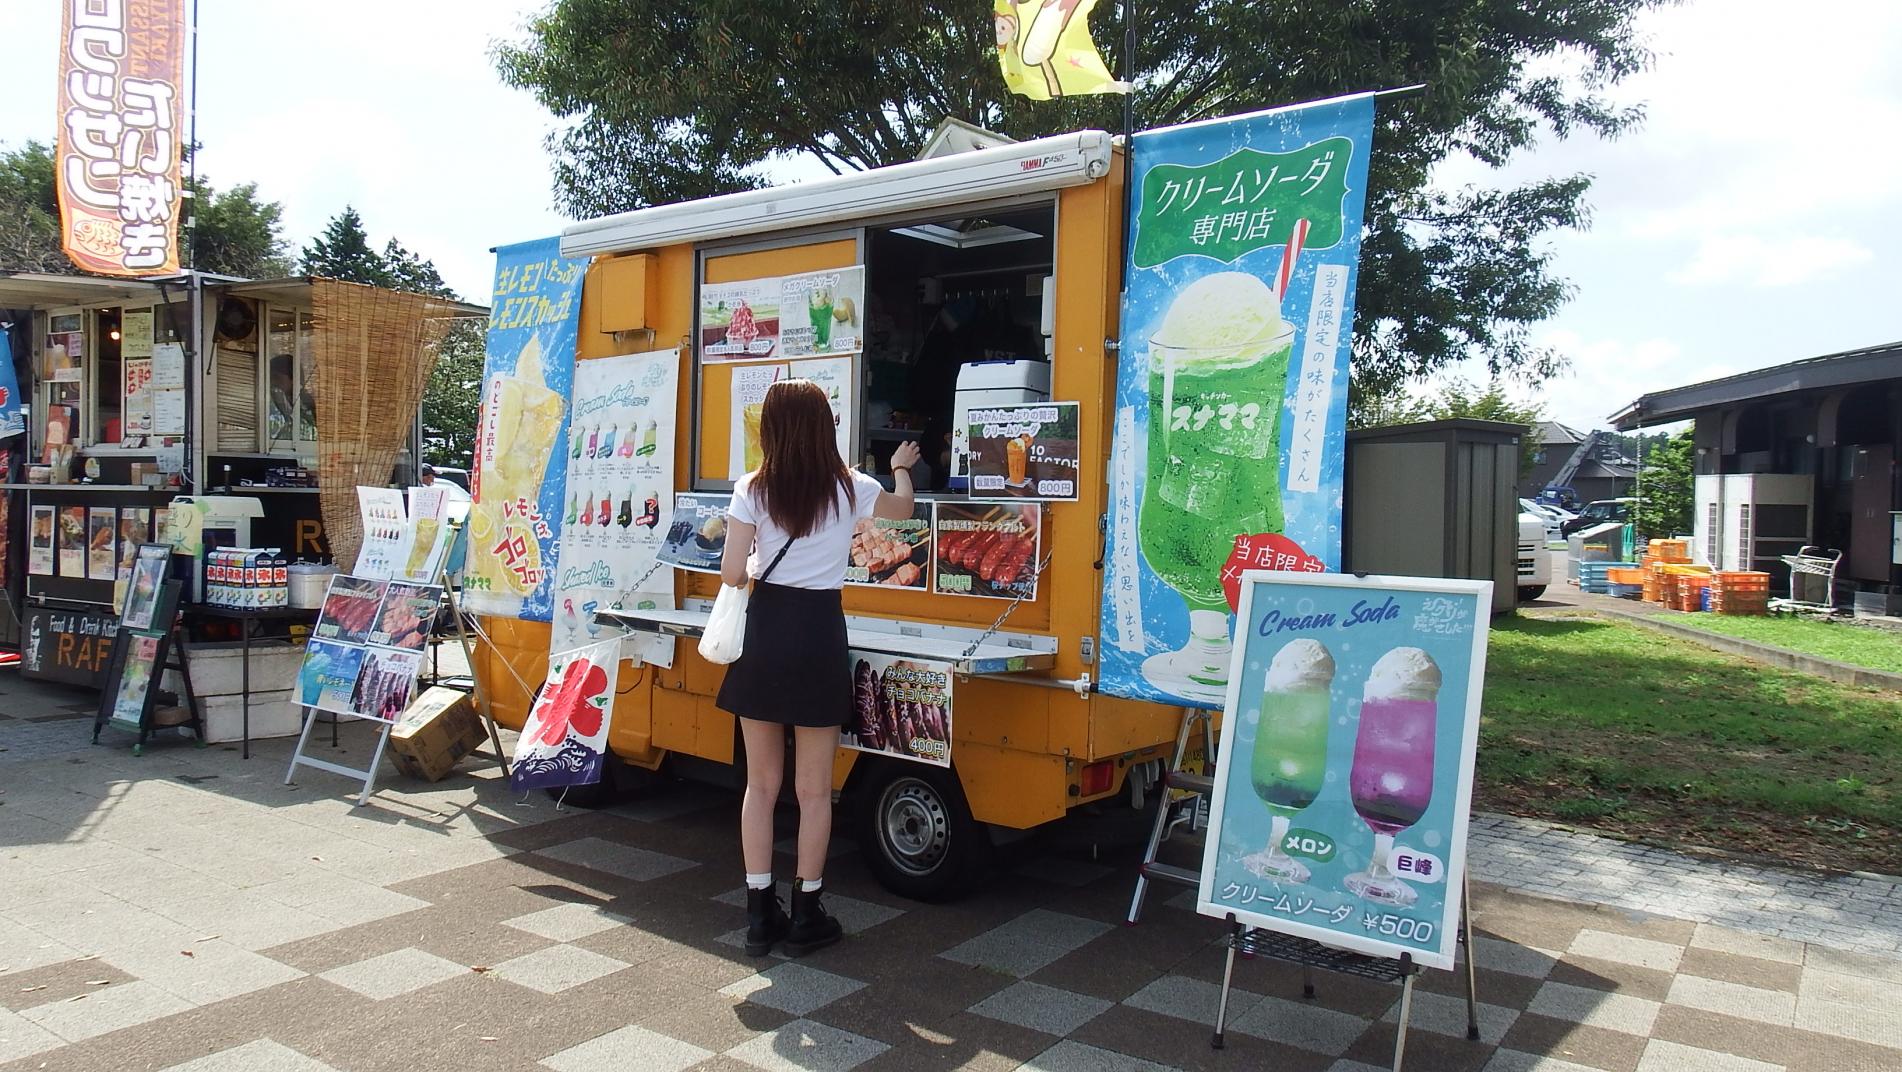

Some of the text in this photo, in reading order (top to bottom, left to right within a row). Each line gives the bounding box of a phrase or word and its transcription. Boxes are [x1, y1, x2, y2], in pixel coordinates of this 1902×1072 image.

[1156, 150, 1335, 217] クリームソーダ
[1188, 207, 1277, 246] 専門店
[1297, 270, 1338, 483] 当店限定の味がたくさん
[740, 383, 771, 392] ぷりのレモ
[1200, 392, 1232, 400] キッチンカー
[1170, 402, 1260, 431] スナママ
[983, 424, 1040, 438] クリームソーダ
[1040, 482, 1071, 493] 800円
[49, 614, 66, 632] Food
[79, 617, 100, 635] Drink
[1258, 609, 1337, 638] Cream
[1342, 596, 1401, 628] Soda
[886, 665, 947, 688] みんな大好き
[886, 685, 947, 706] チョコバナナ
[909, 737, 945, 758] 400円
[1285, 835, 1332, 855] メロン
[1397, 855, 1433, 876] 巨峰
[1221, 881, 1433, 943] クリームソーダ ¥500
